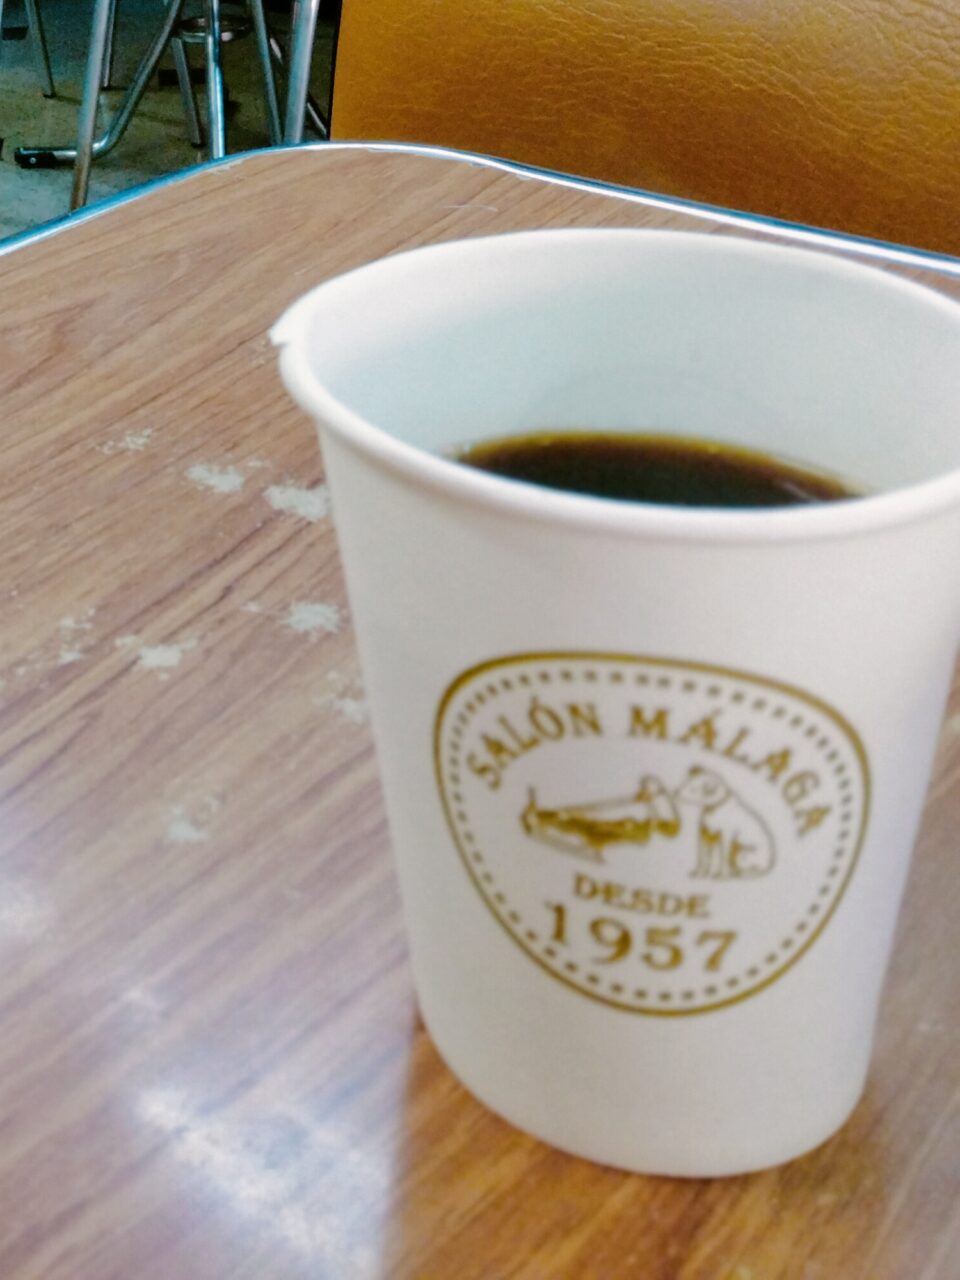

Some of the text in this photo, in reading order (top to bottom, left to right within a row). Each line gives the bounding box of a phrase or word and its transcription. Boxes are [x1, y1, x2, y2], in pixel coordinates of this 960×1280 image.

[467, 694, 832, 838] SALÓN MÁLAGA
[573, 872, 712, 920] DESDE
[544, 902, 738, 973] 1957
